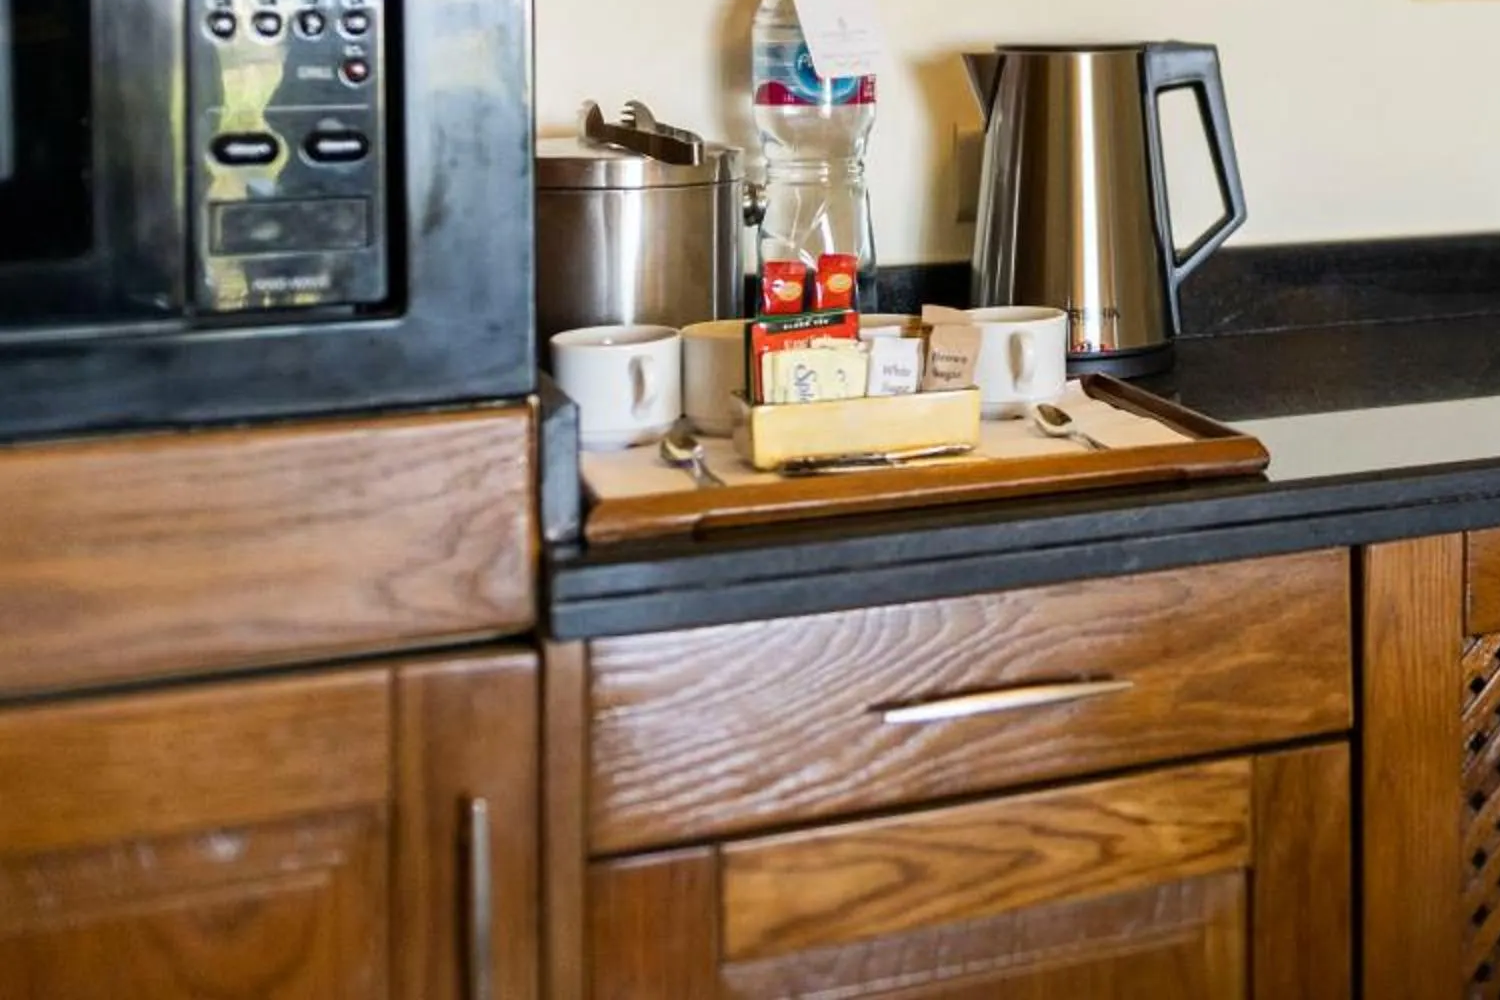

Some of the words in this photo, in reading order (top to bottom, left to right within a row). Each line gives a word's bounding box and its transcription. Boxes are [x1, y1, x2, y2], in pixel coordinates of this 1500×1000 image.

[931, 350, 969, 364] Brown
[882, 363, 912, 377] White
[931, 366, 962, 382] Sugar
